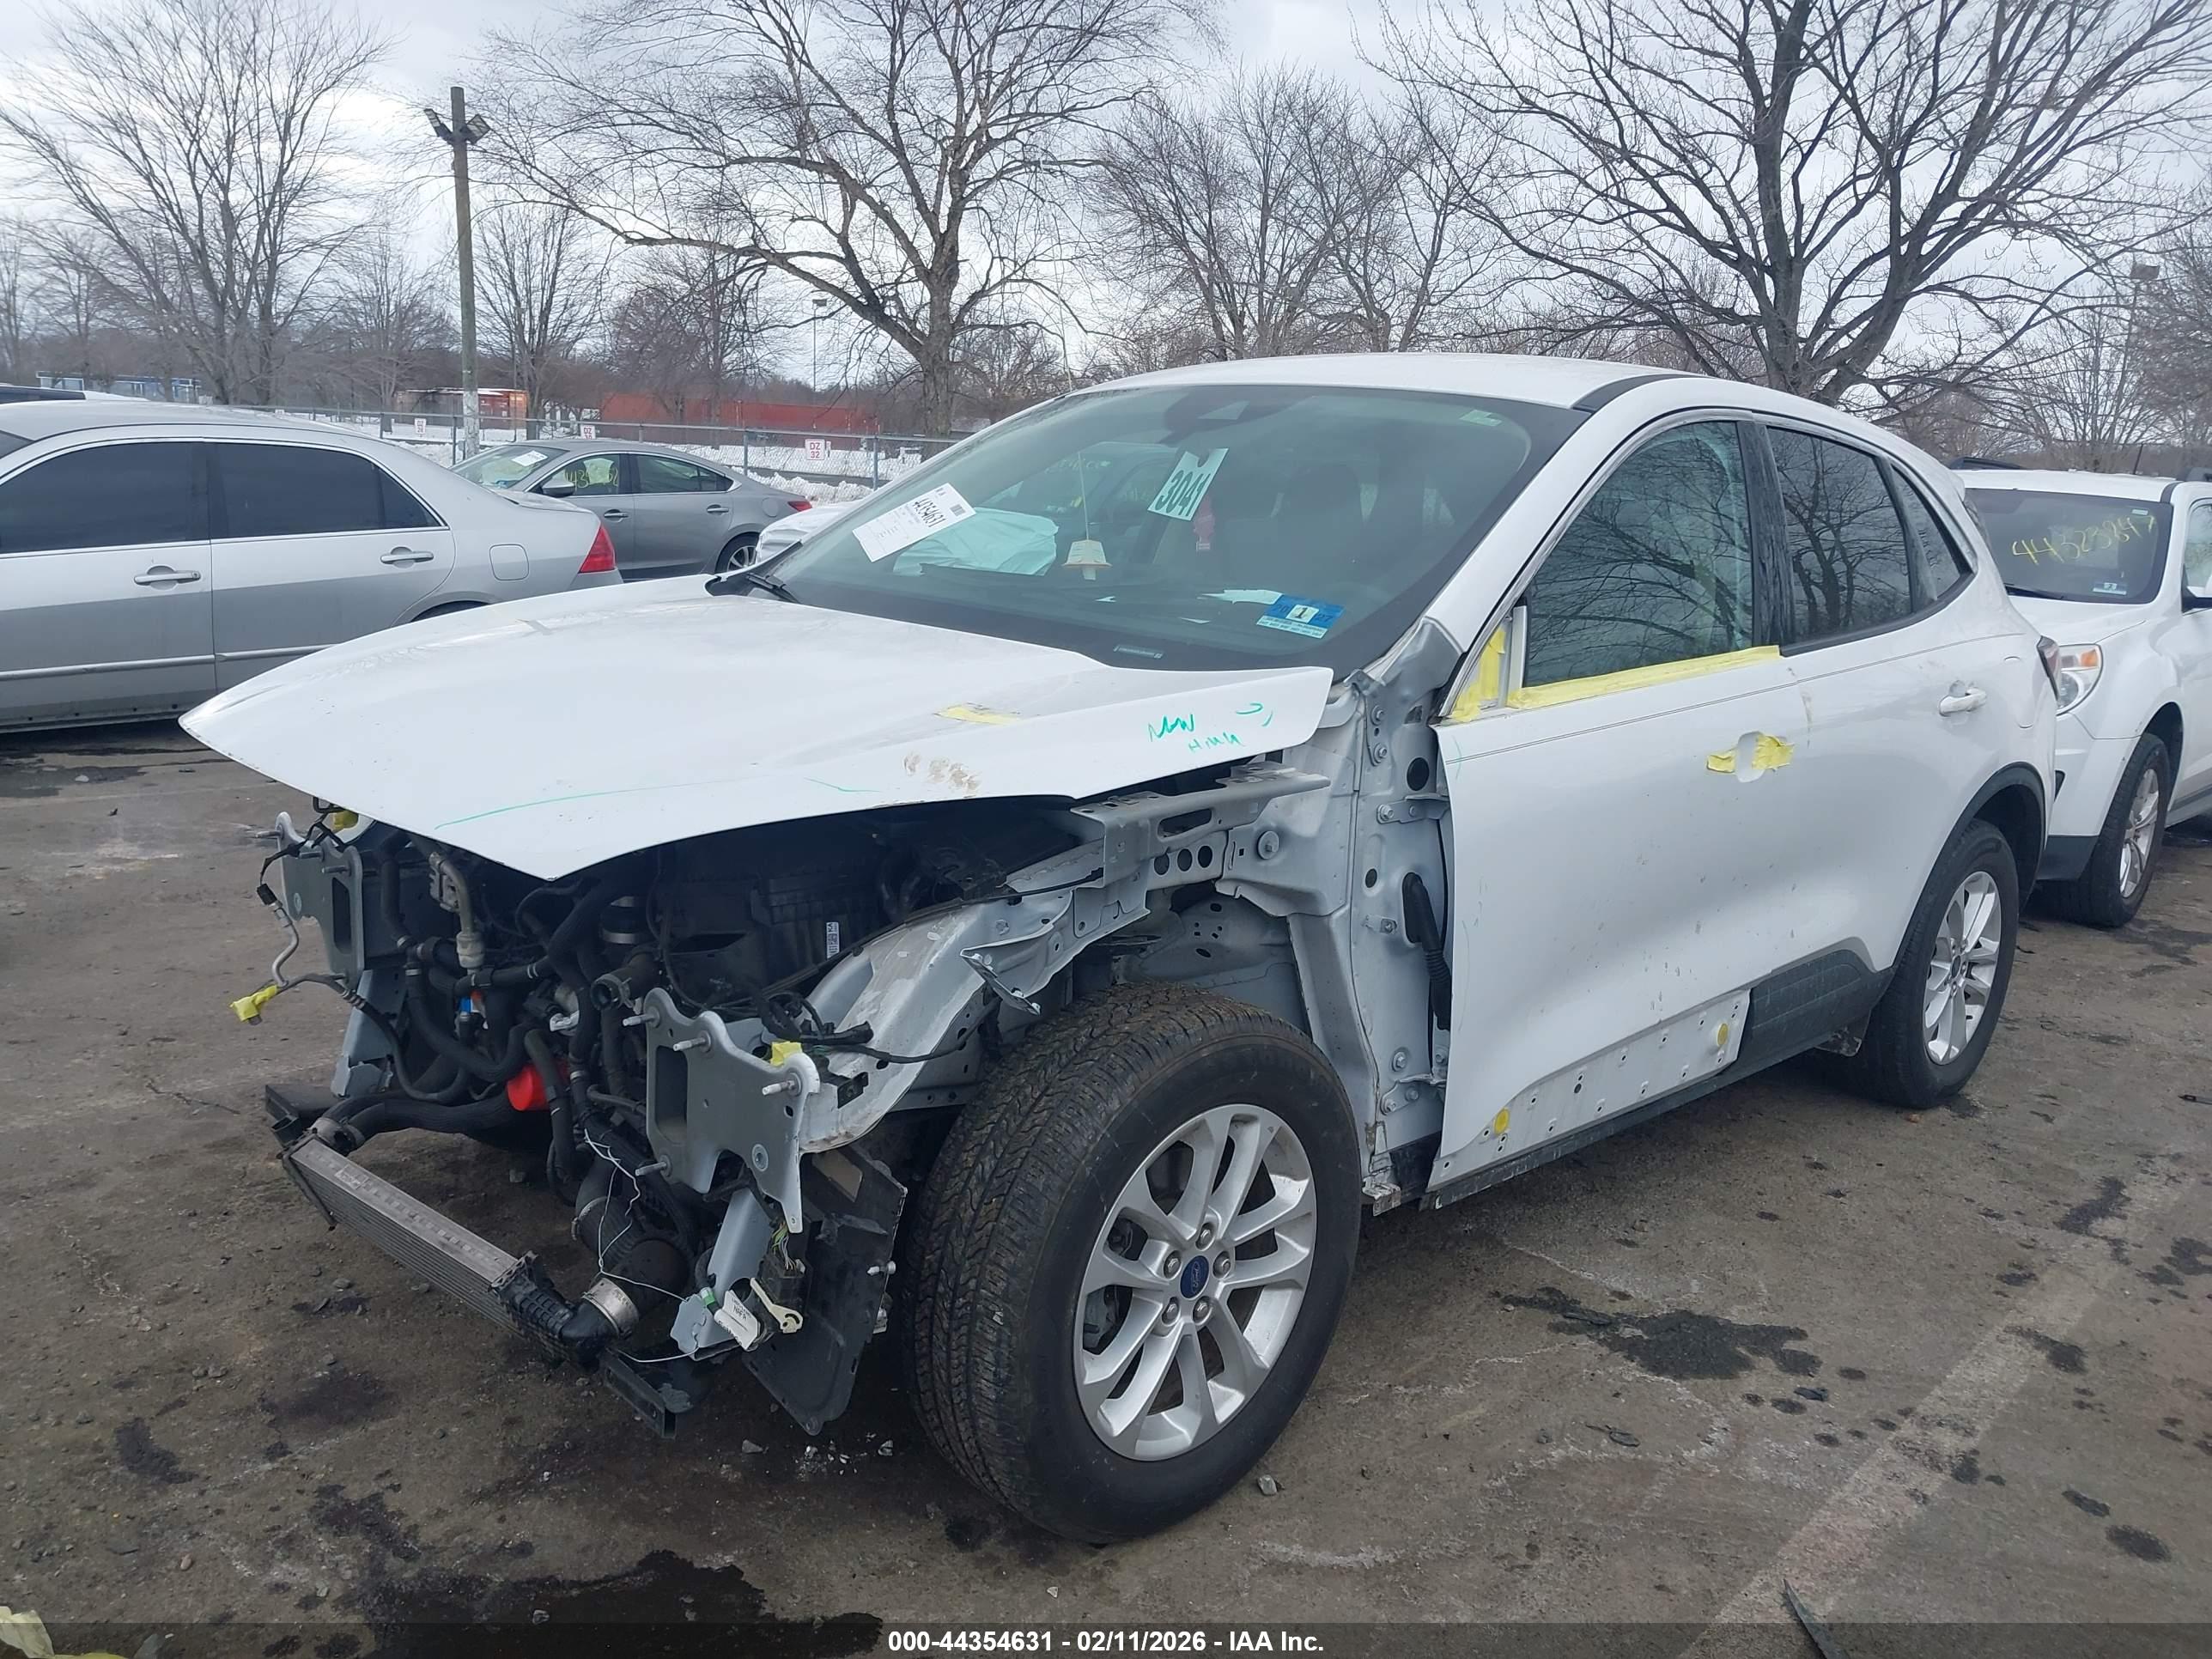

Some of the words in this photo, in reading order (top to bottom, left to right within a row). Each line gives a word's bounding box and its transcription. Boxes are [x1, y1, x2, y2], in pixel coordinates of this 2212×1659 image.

[810, 441, 821, 451] DZ
[1154, 469, 1212, 517] 3041
[912, 497, 946, 528] 44354631
[1295, 607, 1308, 619] 1
